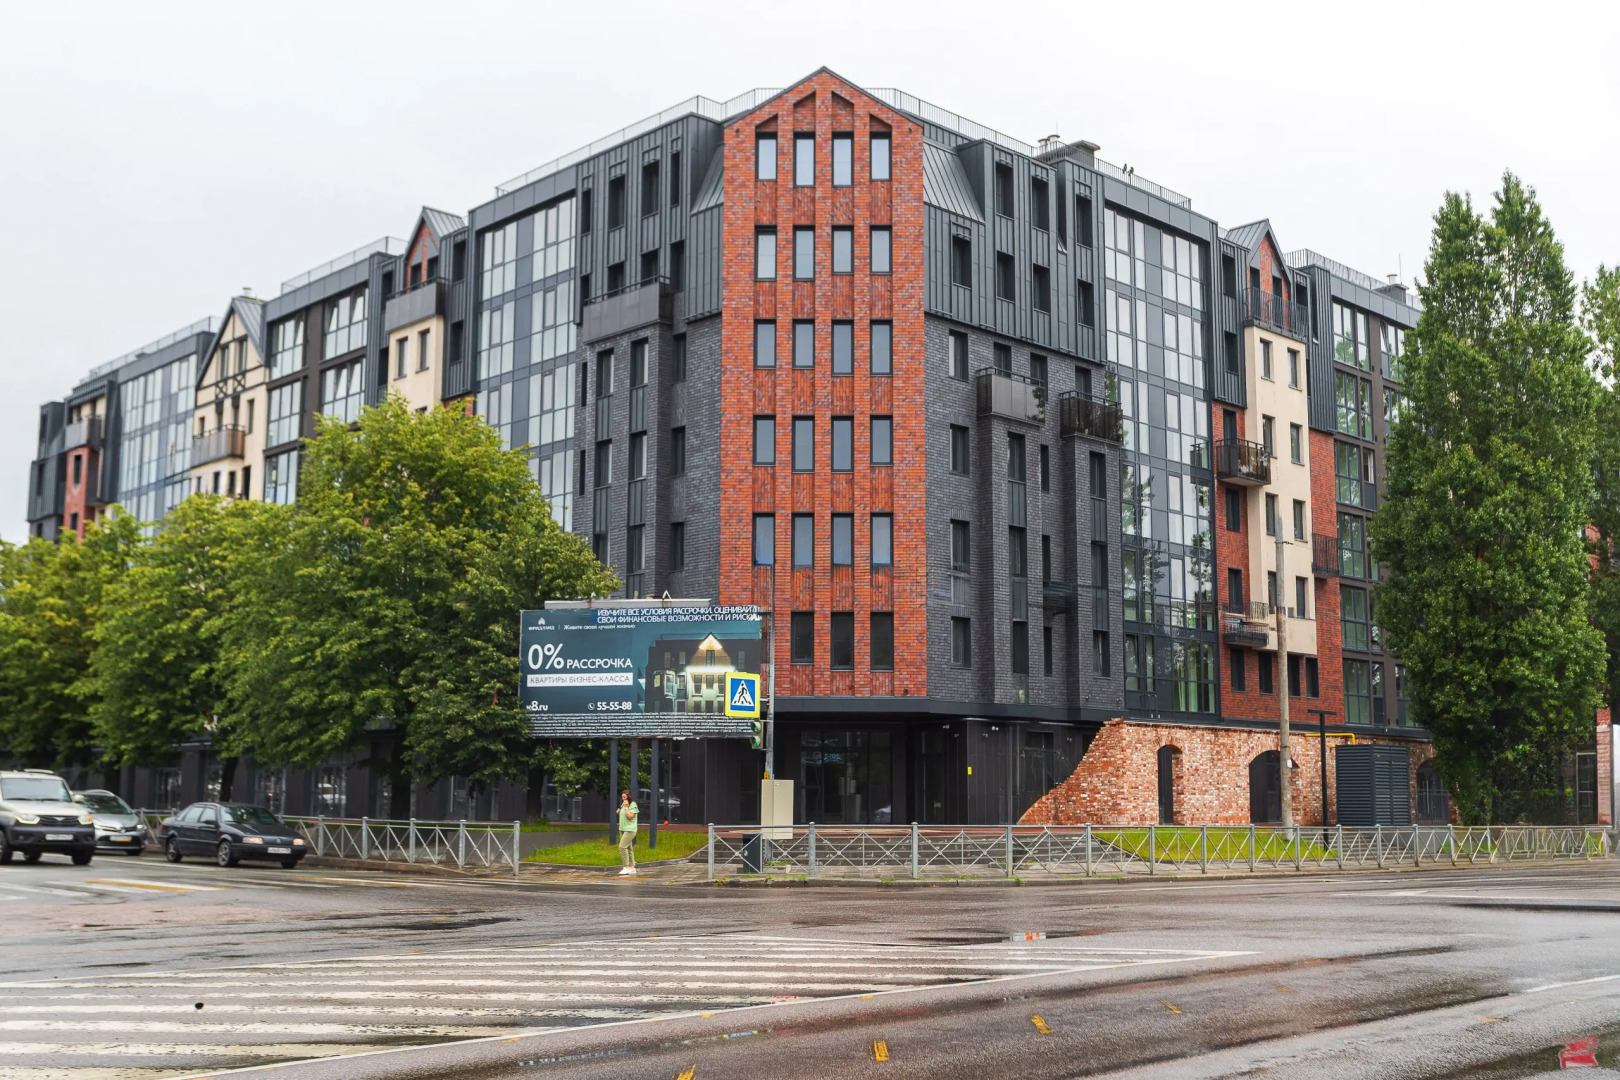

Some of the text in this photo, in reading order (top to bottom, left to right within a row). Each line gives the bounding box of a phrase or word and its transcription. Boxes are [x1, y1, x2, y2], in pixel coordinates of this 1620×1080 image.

[628, 608, 640, 616] ВСЕ
[641, 607, 672, 616] УСЛОВИЯ
[597, 616, 617, 624] СВОИ
[617, 615, 667, 623] ФИНАНСОВЫЕ
[668, 614, 724, 622] ВОЗМОЖНОСТИ
[527, 643, 633, 670] 0% РАССРОЧКА
[530, 675, 630, 684] КВАРТИРЫ БИЗНЕС-КЛАССА
[596, 701, 632, 711] 55-55-88
